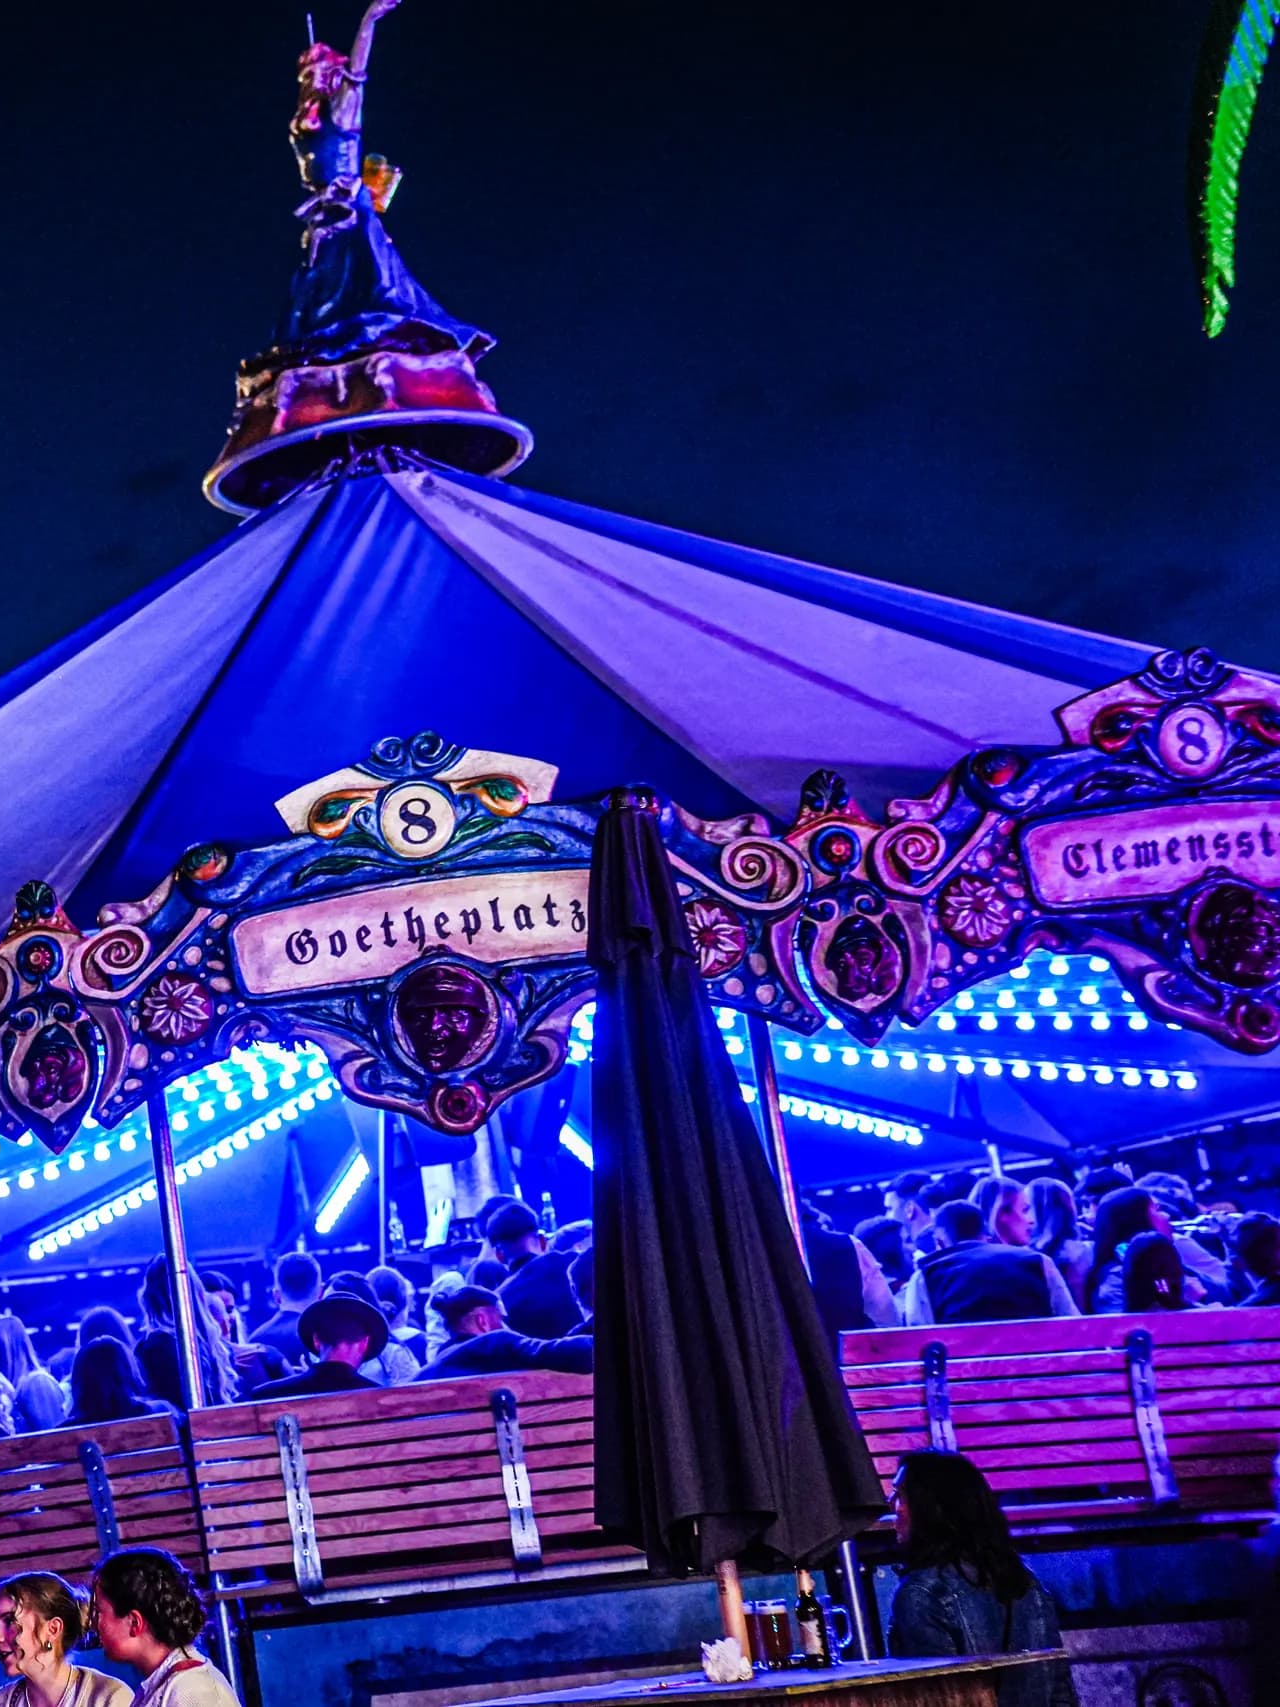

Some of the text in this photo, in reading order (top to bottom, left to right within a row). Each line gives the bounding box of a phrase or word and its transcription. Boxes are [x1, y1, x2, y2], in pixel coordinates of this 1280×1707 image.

[1175, 717, 1211, 765] 8
[397, 797, 438, 845] 8
[1061, 821, 1280, 879] Clemensst
[284, 893, 587, 966] Goetheplatz
